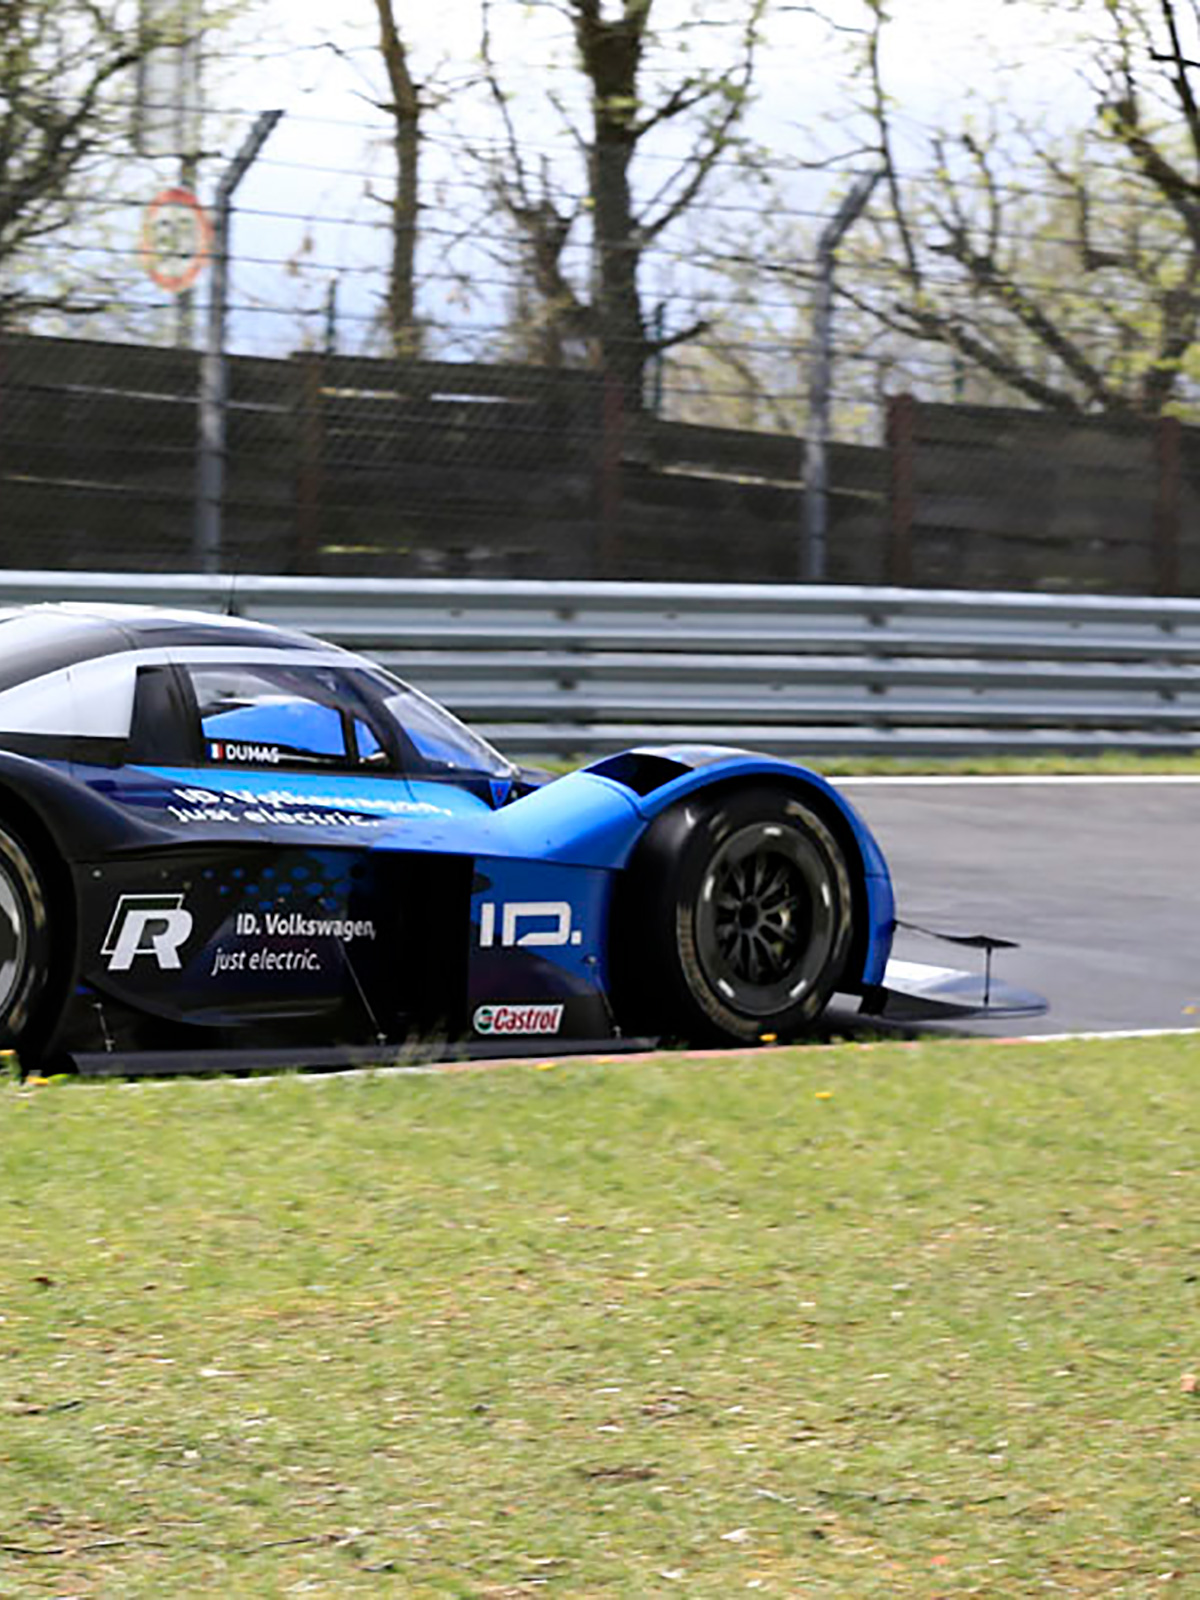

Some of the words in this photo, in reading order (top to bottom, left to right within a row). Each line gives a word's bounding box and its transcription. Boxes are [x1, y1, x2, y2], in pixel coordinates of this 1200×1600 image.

[225, 744, 279, 764] DUMAS
[101, 894, 193, 970] R
[236, 913, 261, 936] ID.
[480, 901, 582, 947] ID.
[211, 948, 247, 976] just
[249, 946, 321, 970] electric.
[494, 1007, 559, 1032] Castrol
